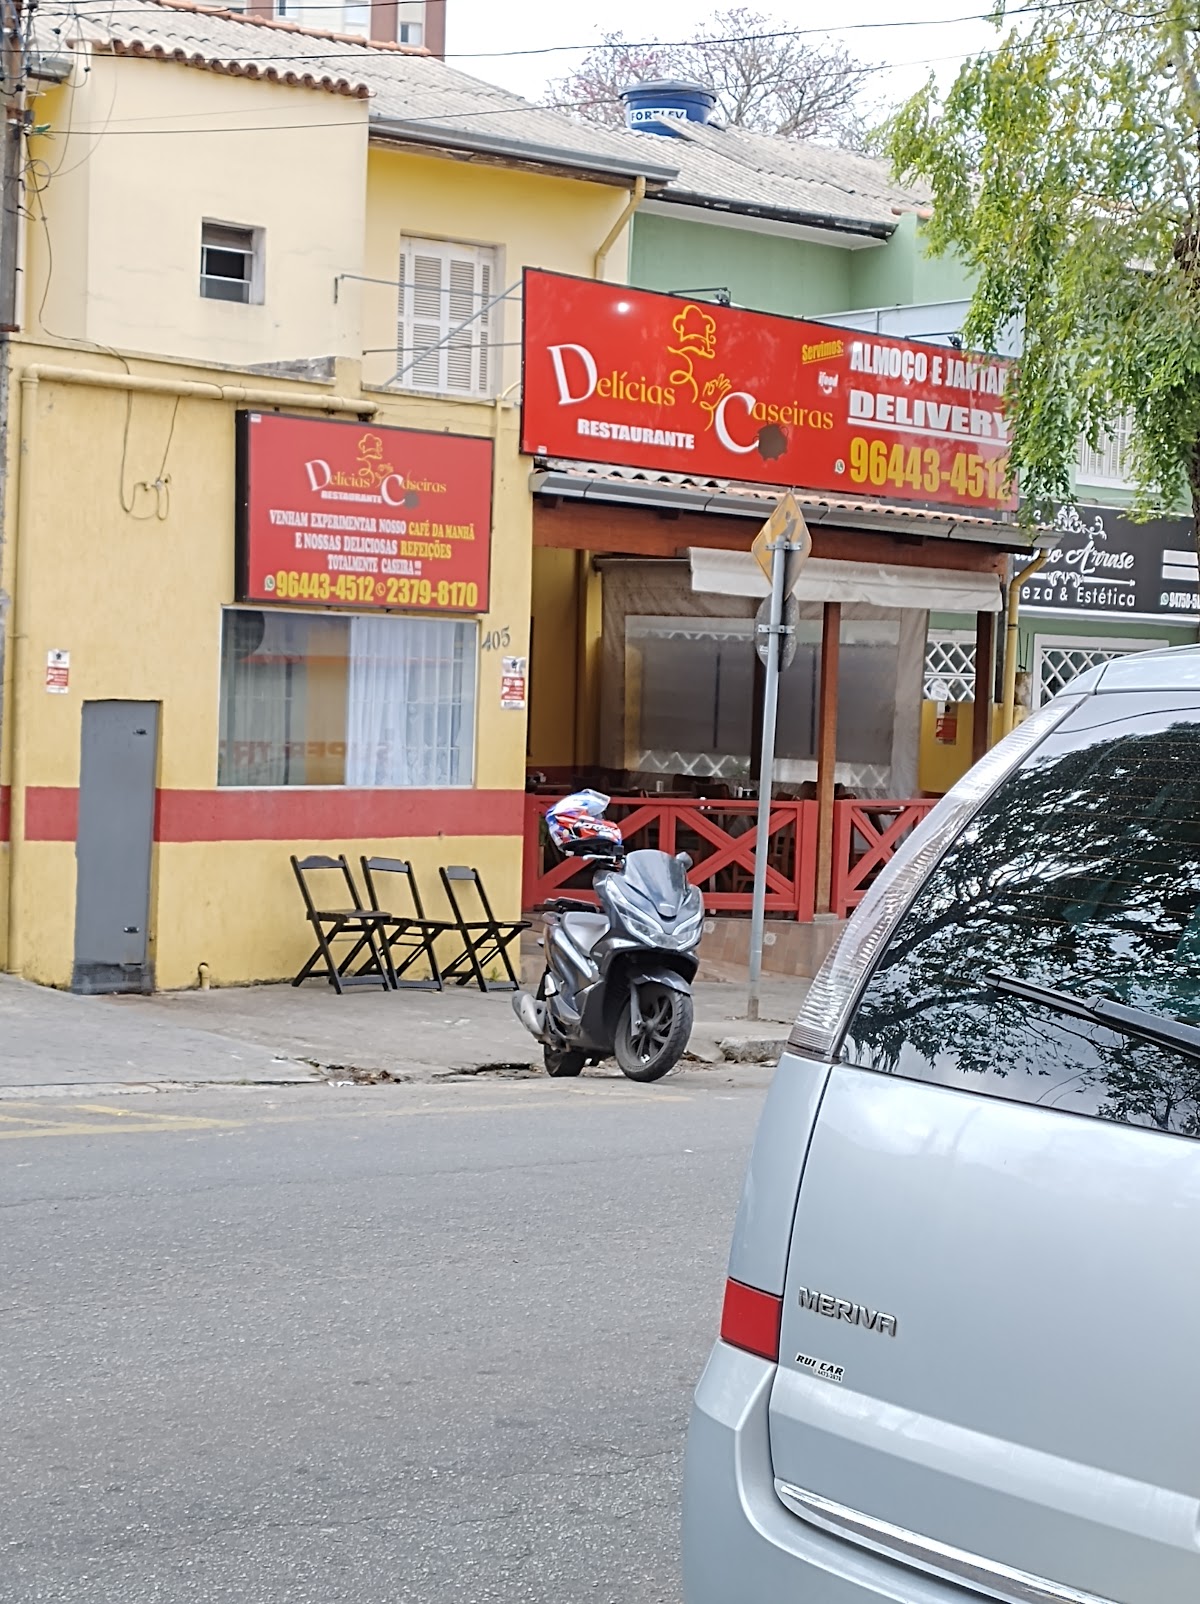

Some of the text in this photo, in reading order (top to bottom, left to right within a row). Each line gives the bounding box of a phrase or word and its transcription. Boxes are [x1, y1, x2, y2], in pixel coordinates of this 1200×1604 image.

[802, 340, 844, 362] Servimos:
[850, 341, 928, 385] ALMOÇO
[932, 355, 942, 386] E
[546, 343, 676, 406] Delícias
[715, 391, 834, 454] Caseiras
[850, 388, 1012, 439] DELIVERY
[577, 418, 695, 450] RESTAURANTE
[304, 459, 448, 507] Delícias Caseiras
[850, 436, 1013, 500] 96443-4512
[320, 489, 383, 505] RESTAURANTE
[269, 509, 476, 541] VENHAM EXPERIMENTAR NOSSO CAFÉ DA MANHÃ
[294, 531, 453, 561] E NOSSAS DELICIOSAS REFEIÇÕES
[327, 553, 379, 573] TOTALMENTE
[276, 570, 479, 608] 96443-4512 2379-8170
[1022, 585, 1137, 608] eza & Estética
[481, 625, 511, 652] 405
[798, 1286, 898, 1338] MERIVA
[796, 1354, 844, 1376] RUI CAR
